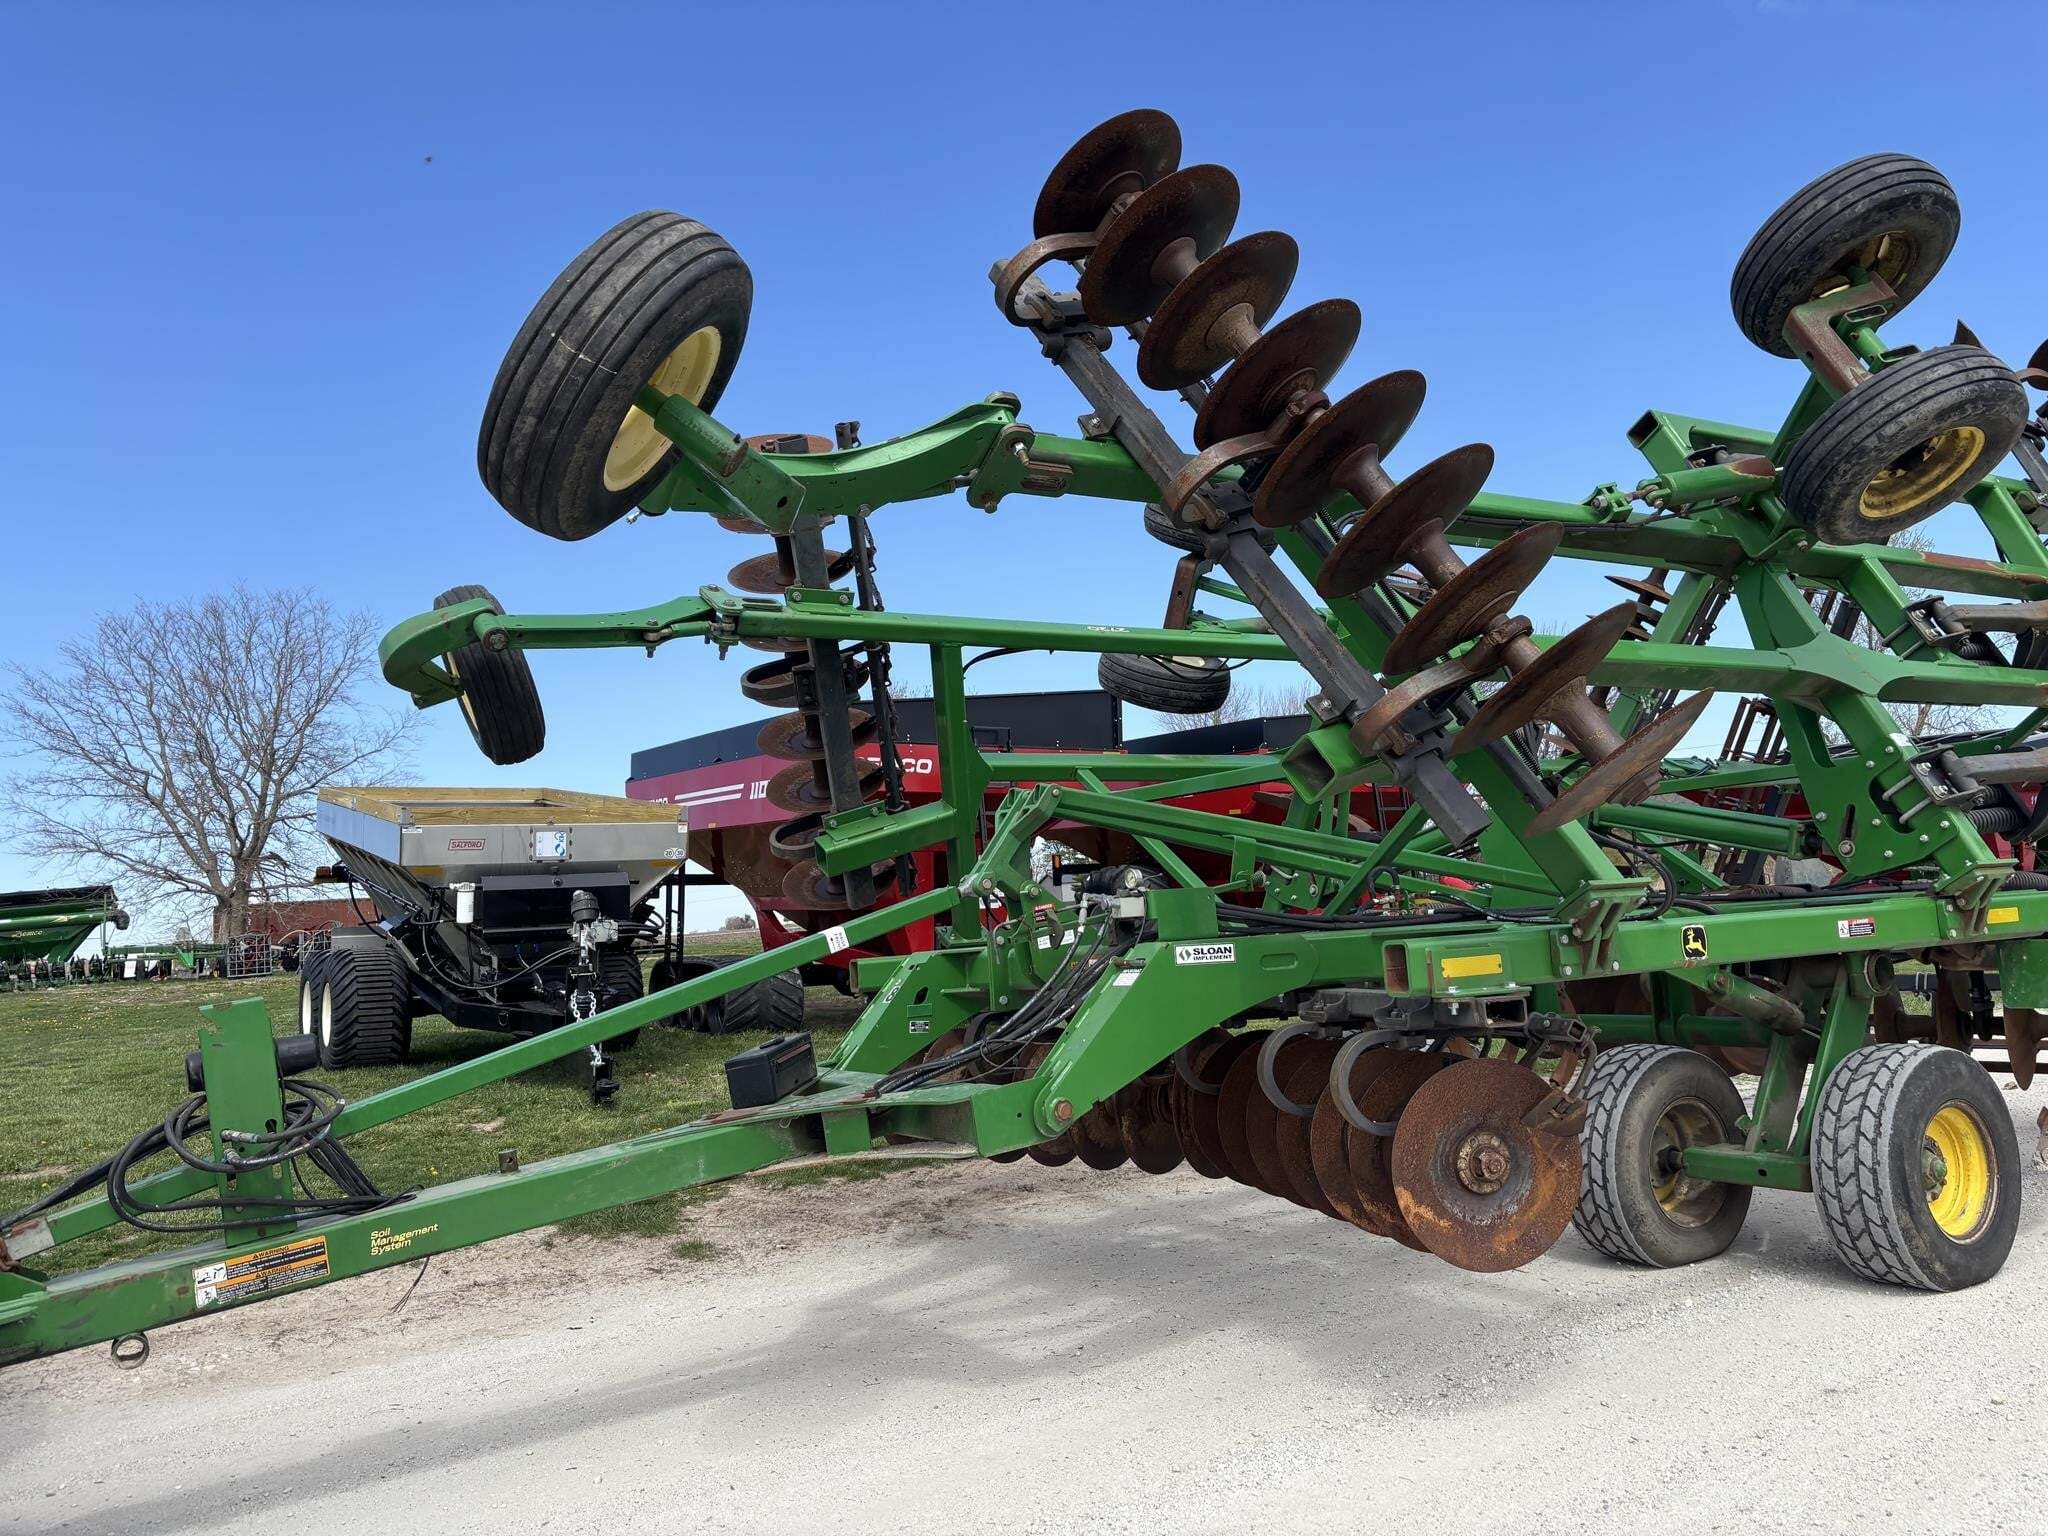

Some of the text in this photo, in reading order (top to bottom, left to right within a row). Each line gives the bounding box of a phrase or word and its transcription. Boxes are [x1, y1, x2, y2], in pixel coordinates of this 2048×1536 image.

[1193, 946, 1232, 956] SLOAN
[370, 1227, 391, 1240] Soil
[370, 1223, 439, 1248] Management
[259, 1245, 290, 1258] WARNING
[370, 1239, 411, 1256] System
[260, 1265, 292, 1278] WARNING
